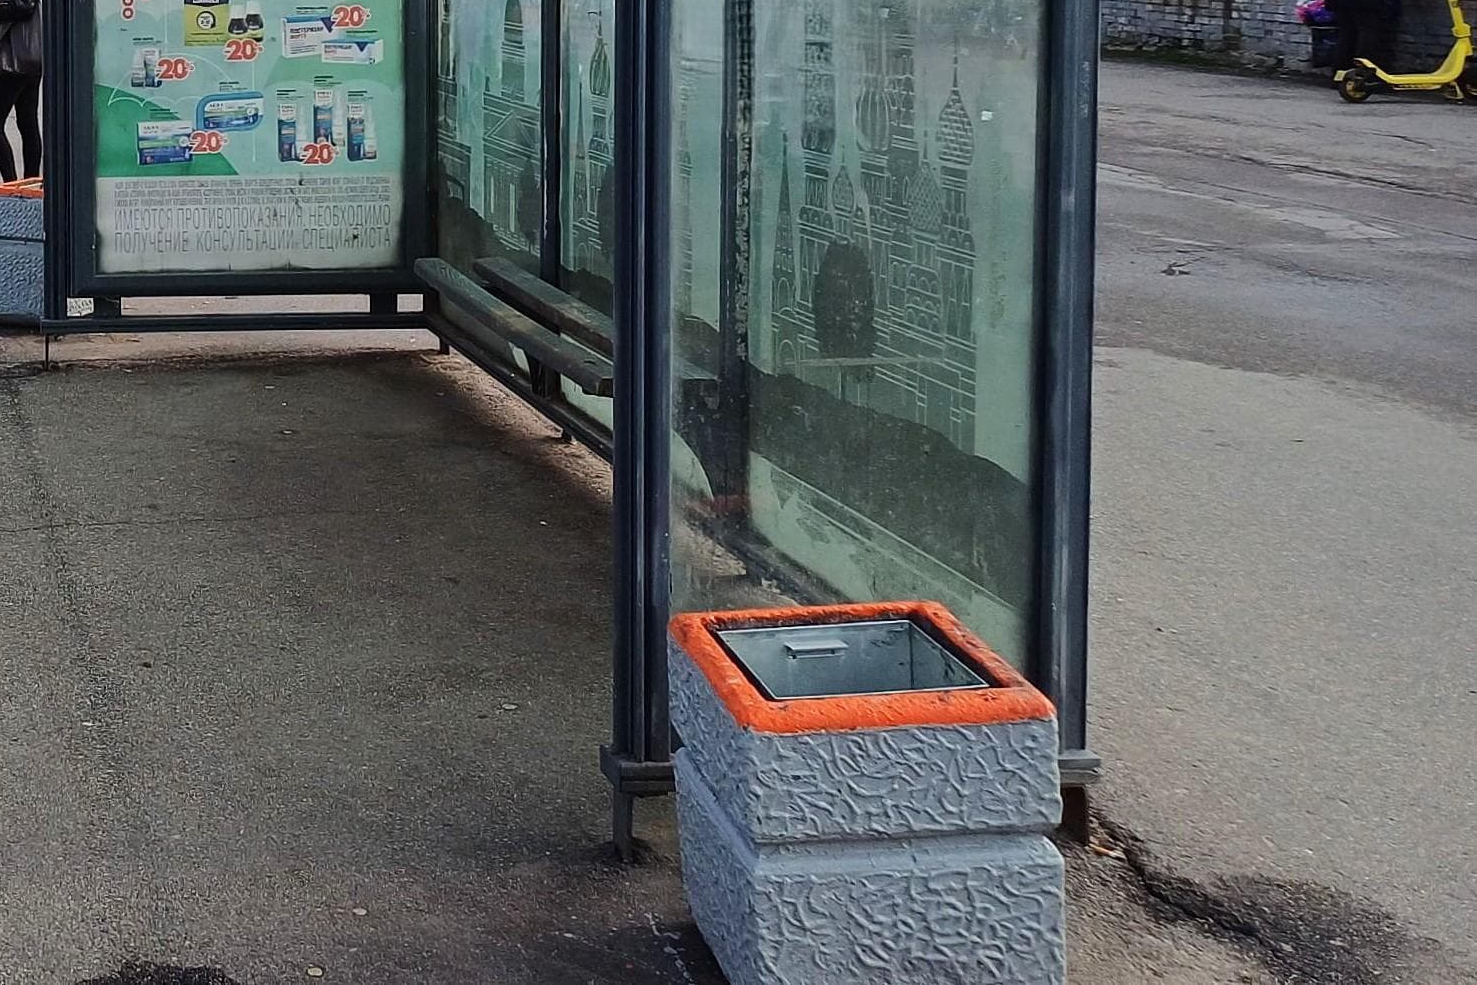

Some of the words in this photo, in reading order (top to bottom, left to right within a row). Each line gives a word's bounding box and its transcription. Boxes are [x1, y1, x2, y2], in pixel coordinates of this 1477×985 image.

[114, 208, 173, 231] ИМЕЮТСЯ
[309, 204, 391, 227] НЕОБХОДИМО
[114, 231, 189, 253] ПОЛУЧЕНИЕ
[196, 229, 294, 252] КОНСУЛЬТАЦИИ
[302, 227, 391, 252] СПЕЦИАЛИСТА
